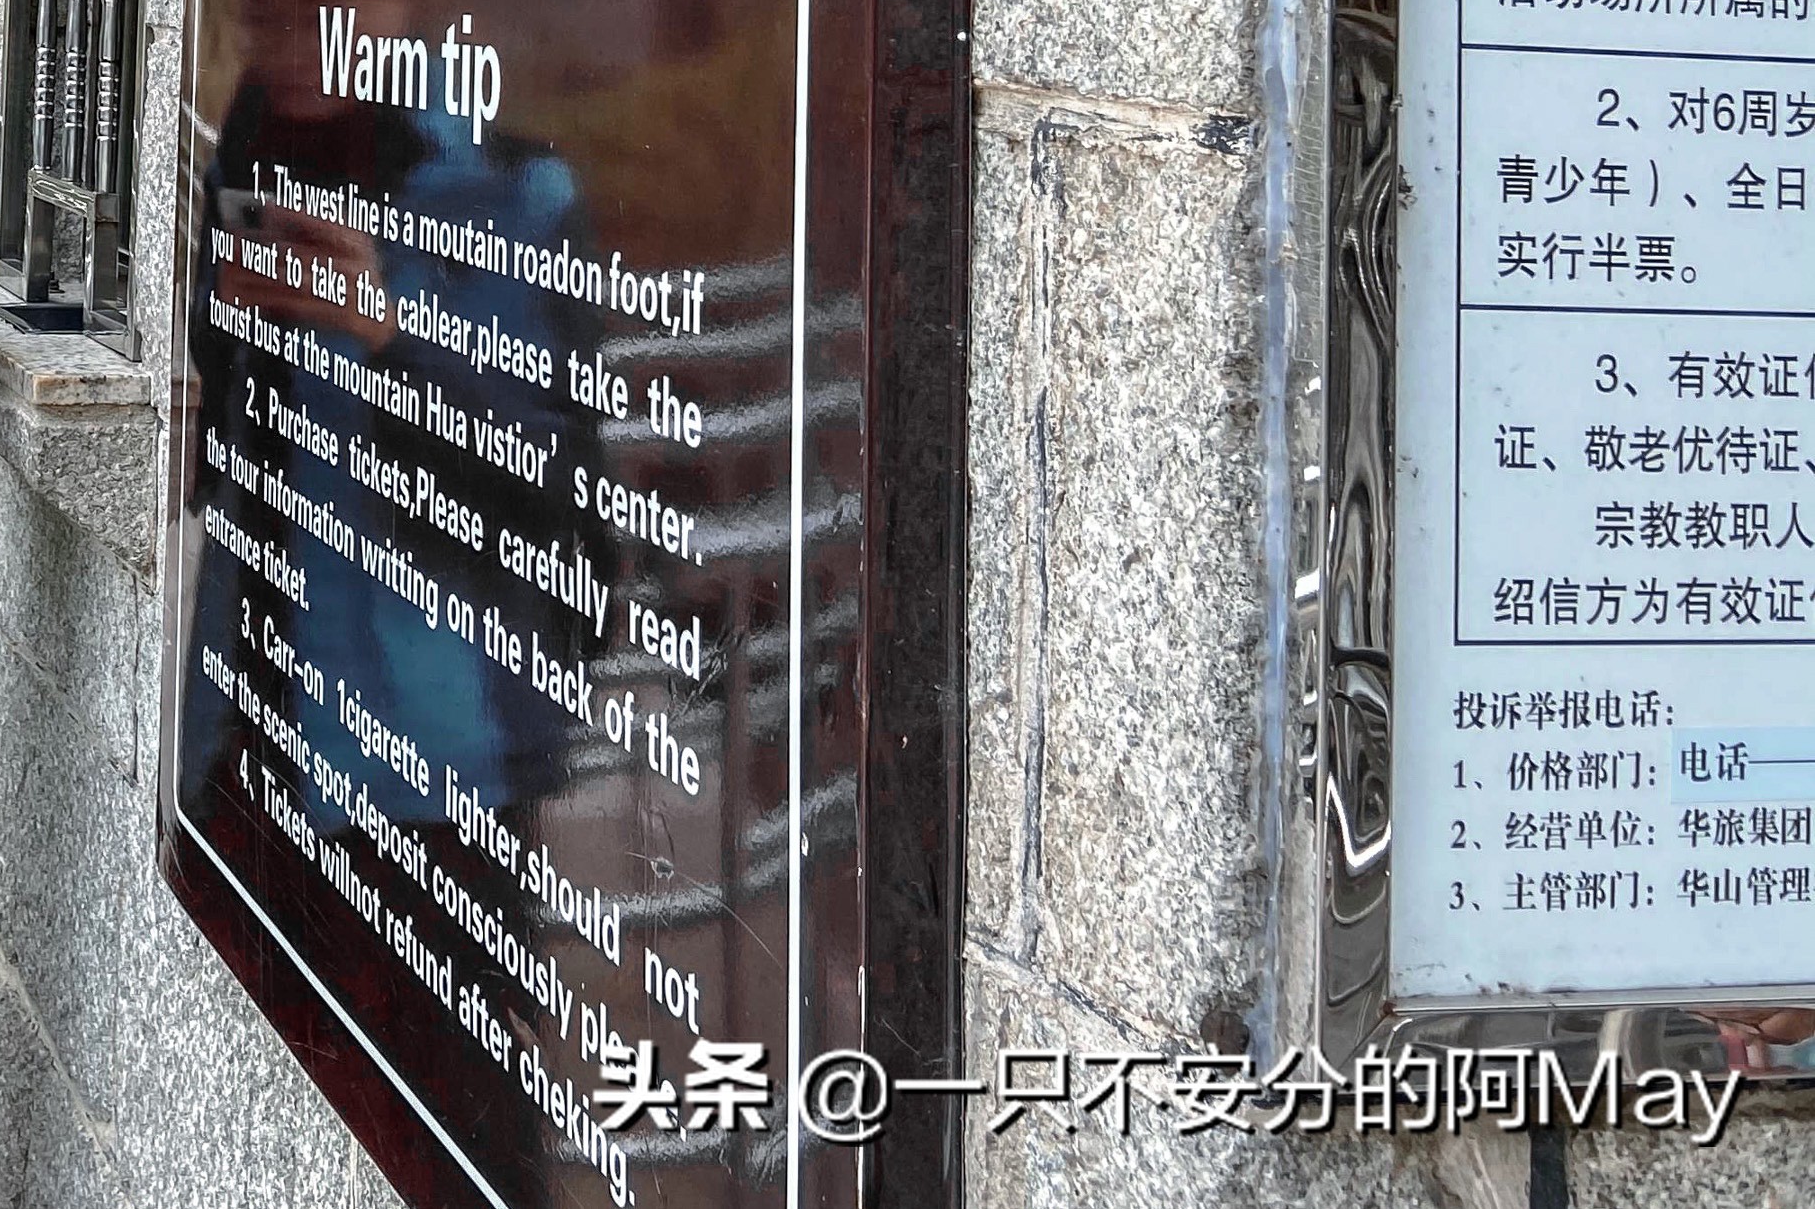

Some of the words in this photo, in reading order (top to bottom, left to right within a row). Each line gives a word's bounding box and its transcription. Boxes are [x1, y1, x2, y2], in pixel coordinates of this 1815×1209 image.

[318, 5, 428, 110] Warm
[441, 13, 502, 145] tip
[274, 164, 302, 212] The
[305, 183, 344, 225] west
[348, 183, 379, 236] line
[384, 192, 398, 242] is
[402, 210, 414, 246] a
[419, 215, 508, 276] moutain
[514, 239, 602, 305] roadon
[1497, 232, 1698, 284] 实行半票。
[212, 227, 234, 264] you
[241, 238, 278, 280] want
[286, 248, 302, 288] to
[311, 256, 346, 307] take
[356, 270, 386, 322] the
[568, 349, 628, 420] take
[647, 376, 702, 448] the
[210, 290, 252, 342] tourist
[254, 306, 280, 356] bus
[284, 328, 300, 366] at
[304, 330, 330, 380] the
[334, 352, 420, 426] mountain
[426, 382, 467, 450] Hua
[596, 477, 702, 566] center.
[205, 504, 260, 572] entrance
[264, 541, 310, 611] ticket.
[268, 387, 338, 466] Purchase
[499, 528, 608, 638] carefully
[628, 600, 700, 682] read
[1595, 500, 1814, 550] 宗教教职人
[206, 426, 226, 472] the
[230, 444, 259, 494] tour
[264, 460, 354, 562] information
[361, 535, 438, 630] writting
[447, 594, 474, 644] on
[483, 606, 522, 674] the
[532, 632, 593, 726] back
[604, 691, 634, 753] of
[645, 712, 700, 796] the
[1494, 576, 1815, 626] 绍信方为有效证
[203, 645, 234, 699] enter
[238, 672, 261, 724] the
[264, 704, 310, 774] scenic
[432, 865, 573, 1040] consciously
[262, 766, 316, 862] Tickets
[386, 908, 452, 1011] refund
[458, 982, 512, 1072] after
[519, 1044, 635, 1208] cheking.
[645, 946, 699, 1035] not
